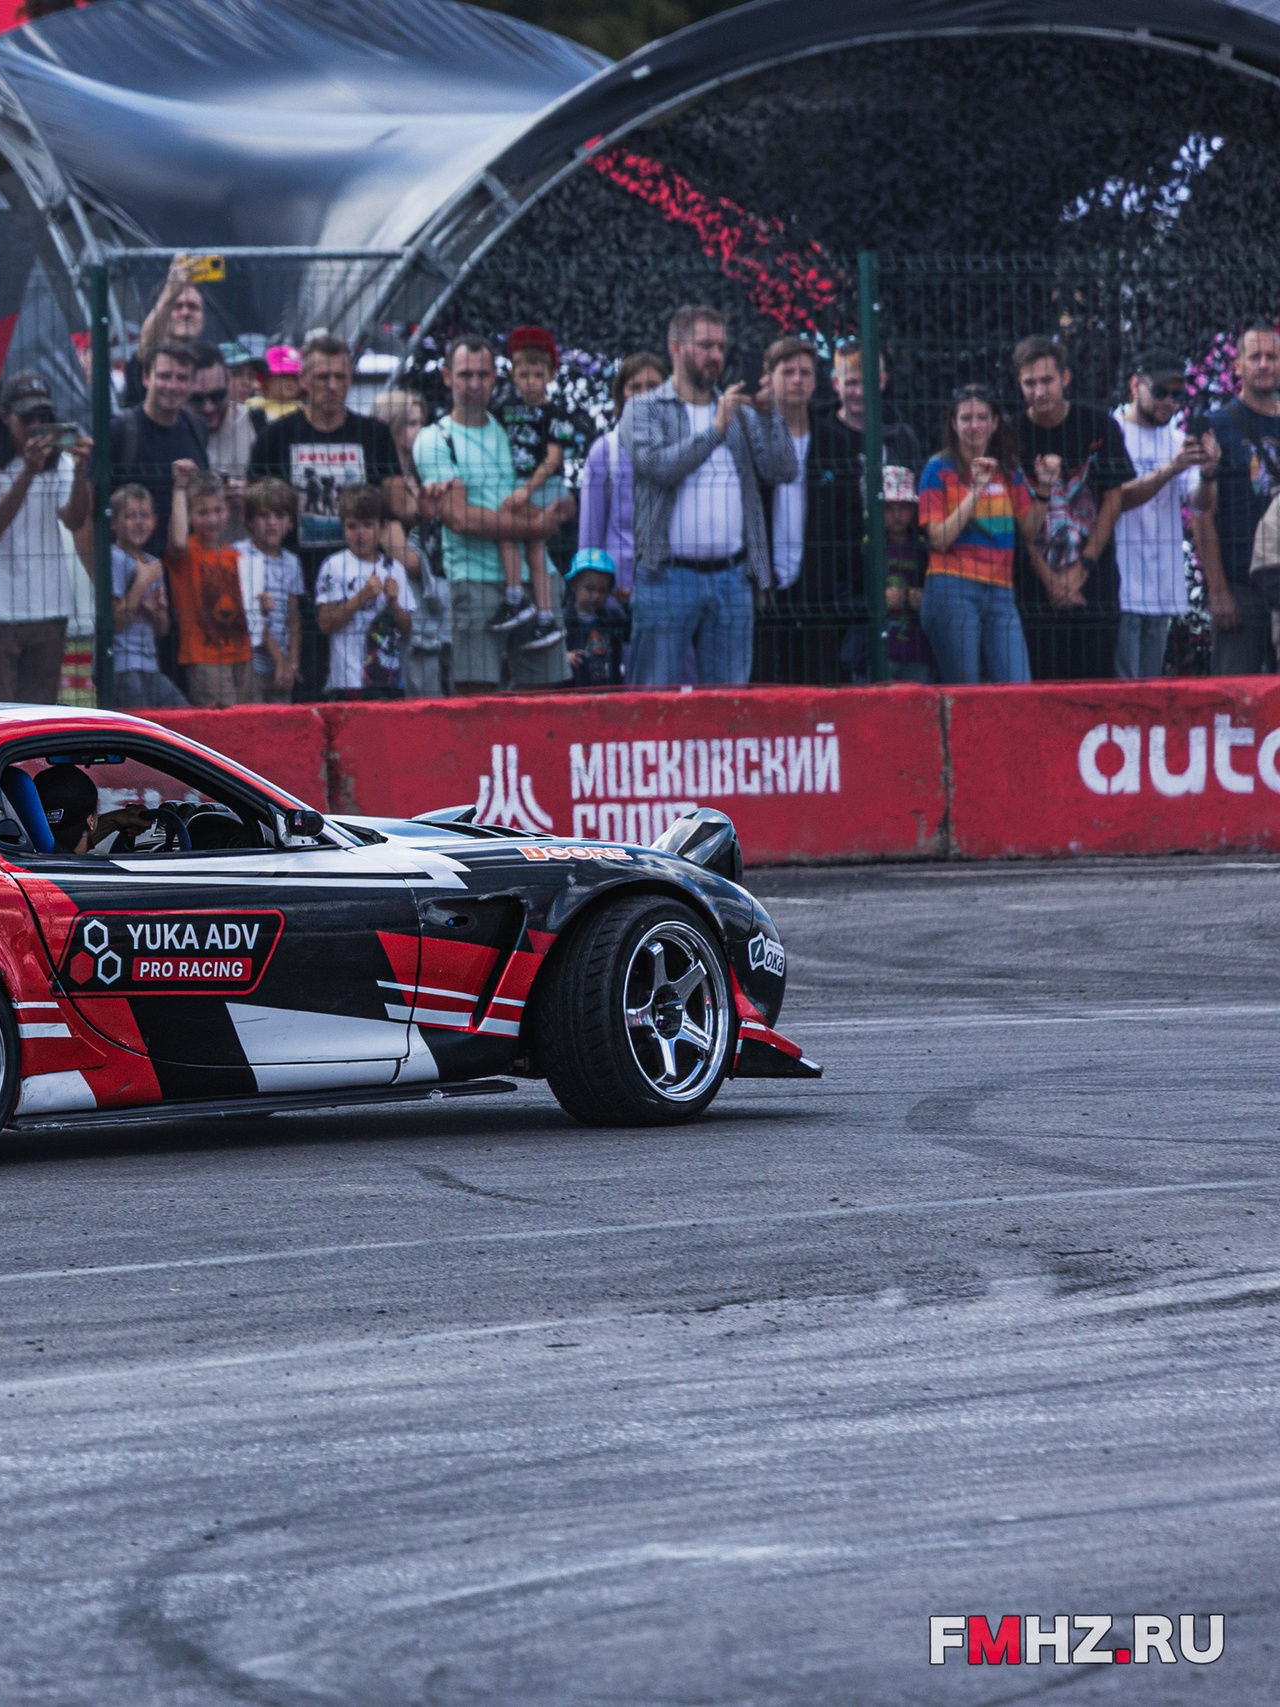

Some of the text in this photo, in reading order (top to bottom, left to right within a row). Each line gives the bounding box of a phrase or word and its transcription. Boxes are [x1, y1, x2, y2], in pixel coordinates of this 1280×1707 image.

[569, 723, 841, 800] МОСКОВСКИЙ
[126, 924, 260, 950] YUKA ADV
[139, 961, 243, 978] PRO RACING
